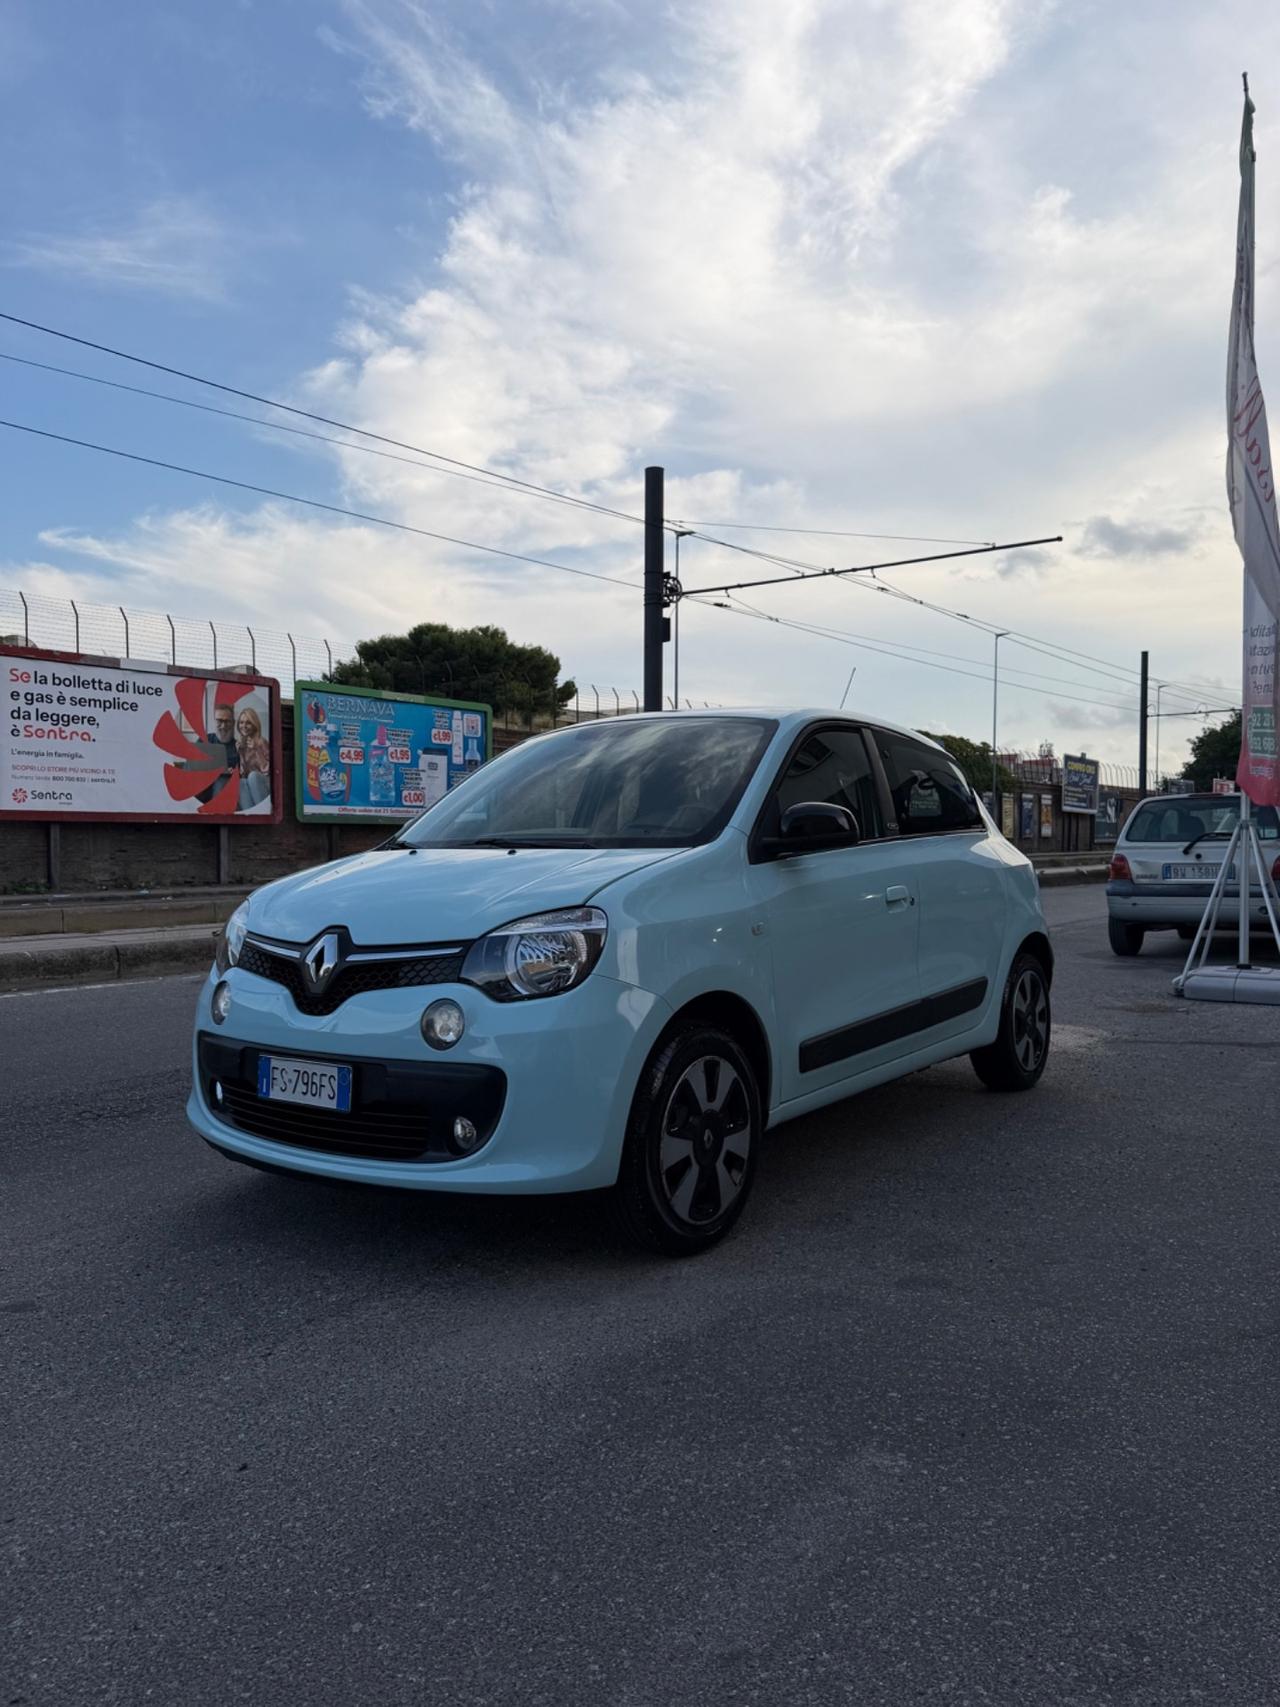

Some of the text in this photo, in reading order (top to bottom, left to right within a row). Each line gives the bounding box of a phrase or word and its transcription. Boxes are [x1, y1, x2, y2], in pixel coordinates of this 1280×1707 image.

[9, 668, 163, 697] Se la bolletta di luce
[10, 690, 139, 713] e gas è semplice
[328, 695, 395, 716] BERNAVA
[10, 706, 100, 729] da leggere,
[10, 723, 96, 743] è Sentra.
[11, 748, 84, 760] L'energia in famiglia.
[30, 790, 73, 800] Sentra
